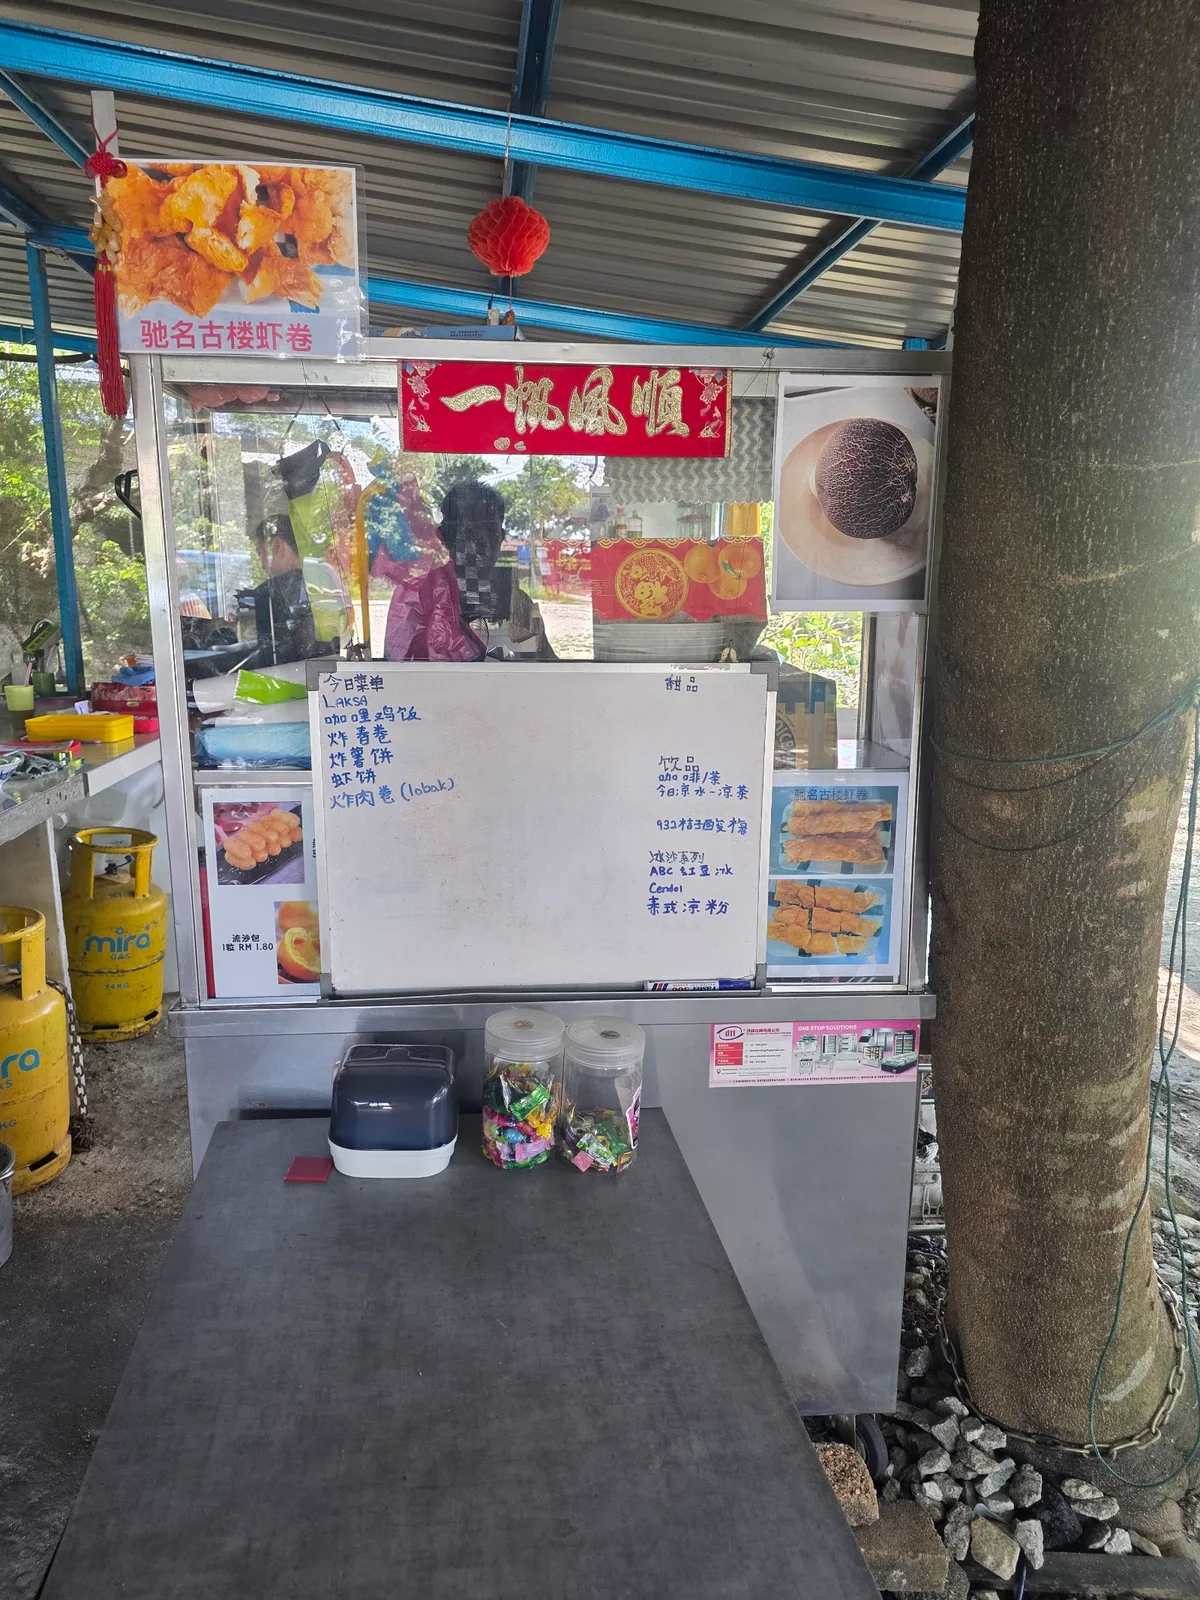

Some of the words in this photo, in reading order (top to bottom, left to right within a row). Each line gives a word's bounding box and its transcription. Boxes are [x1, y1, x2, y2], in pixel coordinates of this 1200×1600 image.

[139, 319, 313, 353] 驰名古楼虾卷
[323, 673, 384, 692] 今日菜单
[664, 674, 698, 692] 甜品
[322, 694, 368, 708] LAKSA
[324, 705, 421, 726] 咖哩鸡饭
[327, 724, 392, 747] 炸春卷
[329, 746, 394, 768] 炸薯饼
[658, 755, 700, 772] 饮品
[331, 768, 377, 788] 虾饼
[329, 784, 395, 809] 炸肉卷
[399, 777, 456, 802] (lobak)
[794, 788, 868, 801] 驰名古楼虾卷
[648, 849, 705, 865] 冰沙系列
[649, 865, 674, 877] ABC
[680, 863, 734, 877] 红豆冰
[648, 881, 683, 894] Cendol
[232, 933, 260, 943] 流沙包
[238, 943, 252, 951] RM
[255, 943, 274, 951] 1.80
